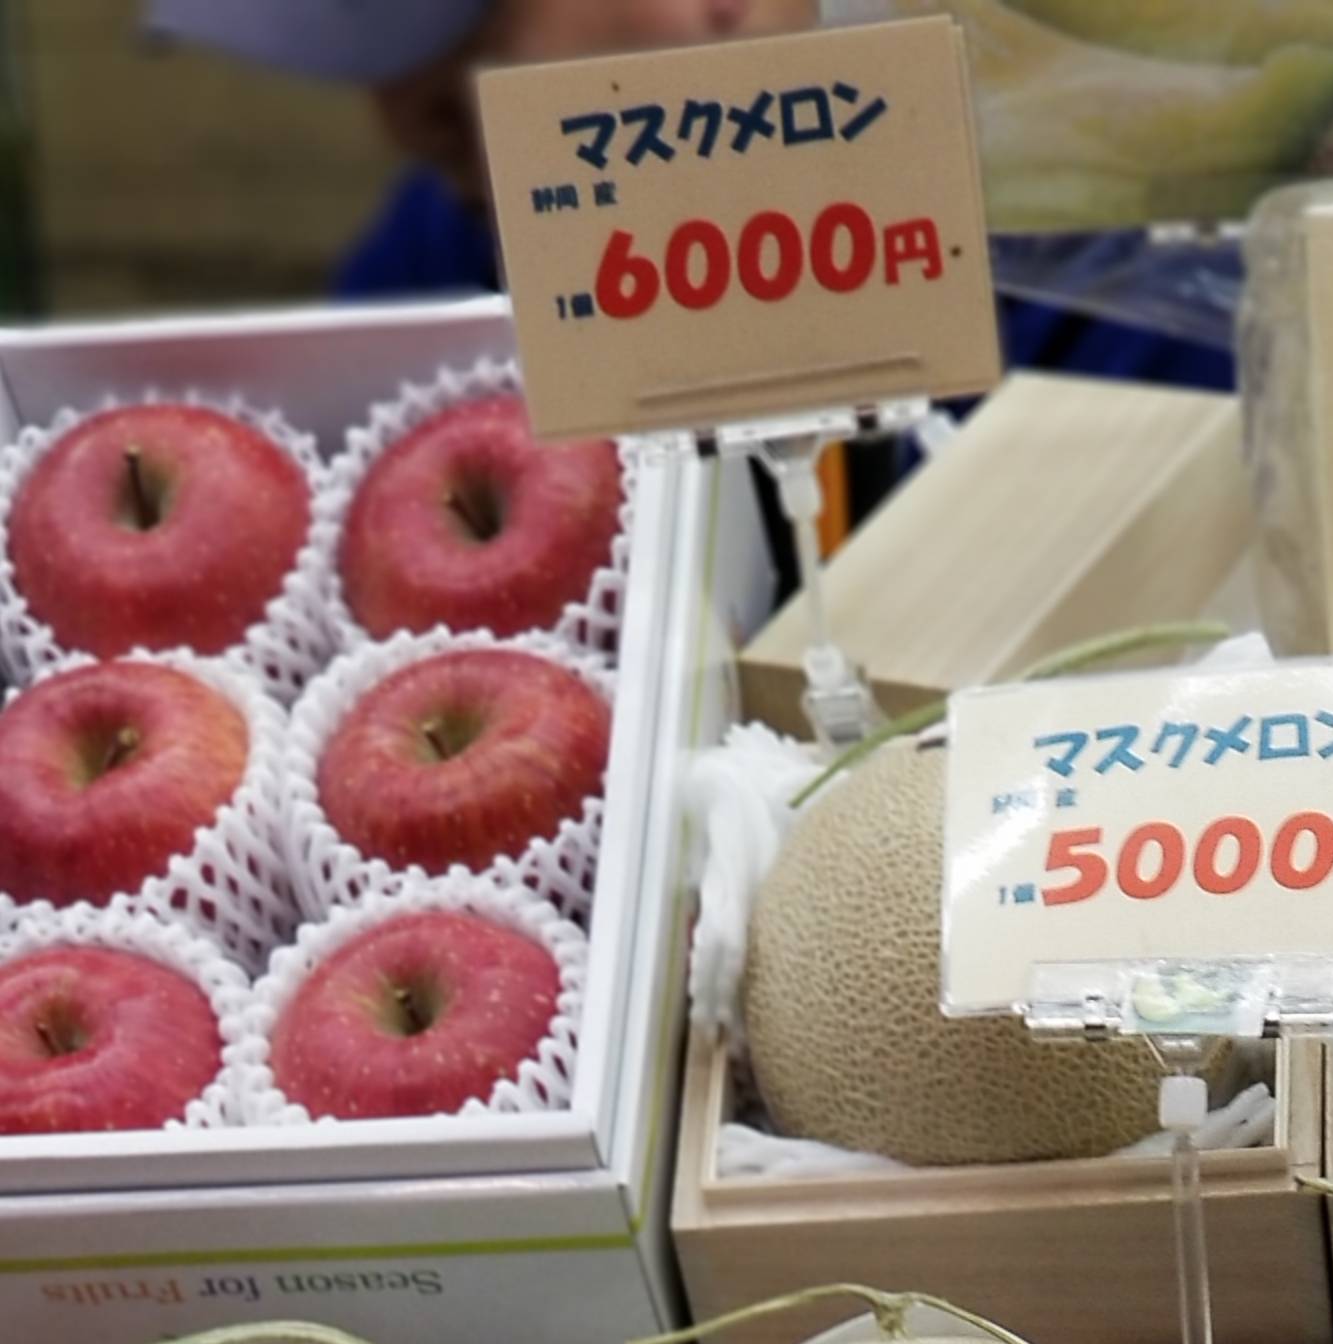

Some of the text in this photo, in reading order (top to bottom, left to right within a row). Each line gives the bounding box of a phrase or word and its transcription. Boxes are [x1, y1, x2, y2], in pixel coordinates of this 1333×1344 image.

[561, 81, 888, 170] マスクメロン
[594, 201, 945, 321] 6000円
[197, 1274, 261, 1303] for
[273, 1268, 444, 1297] Season
